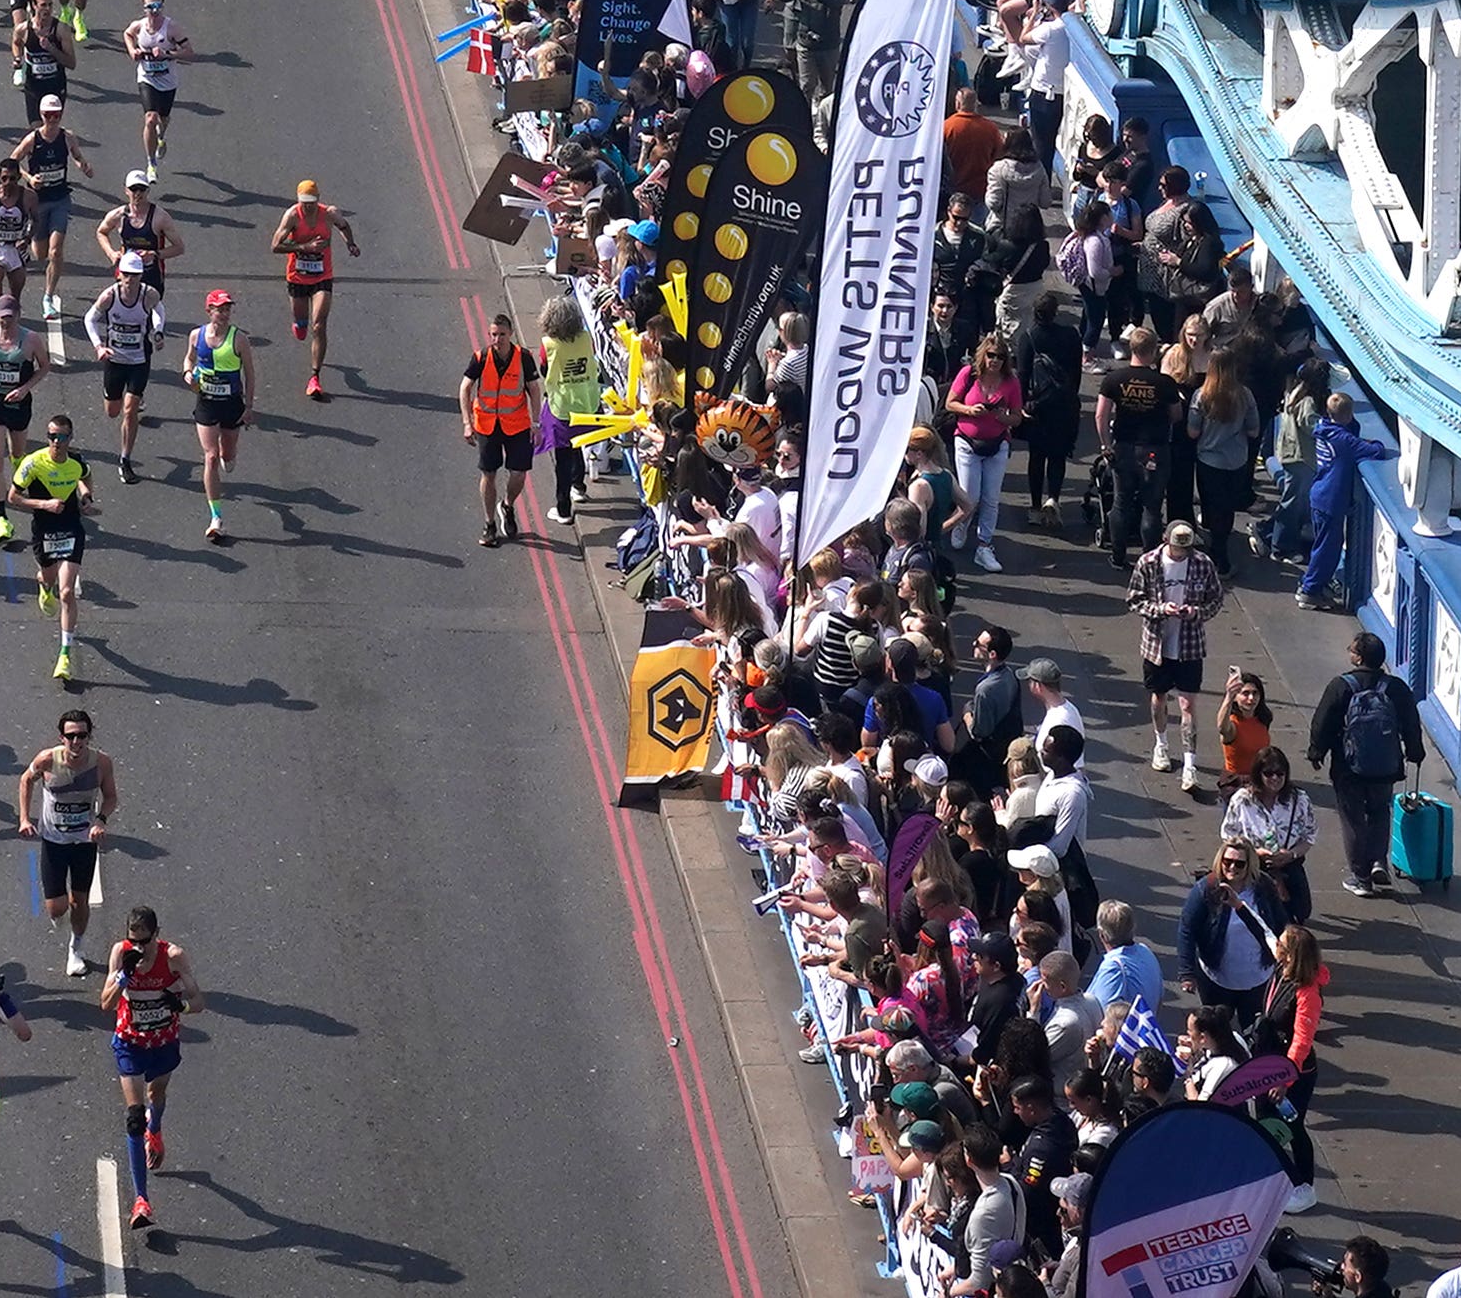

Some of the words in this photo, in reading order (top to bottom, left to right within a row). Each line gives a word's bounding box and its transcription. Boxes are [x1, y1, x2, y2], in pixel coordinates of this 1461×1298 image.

[600, 16, 651, 31] Change
[601, 1, 642, 16] Sight.
[732, 184, 802, 220] Shine
[722, 264, 784, 372] shinecharity.org.uk
[1119, 383, 1156, 399] VANS
[1220, 1068, 1292, 1102] Sub3travel
[1149, 1215, 1250, 1255] TEENAGE
[1158, 1238, 1247, 1274] CANCER
[1165, 1262, 1234, 1293] TRUST
